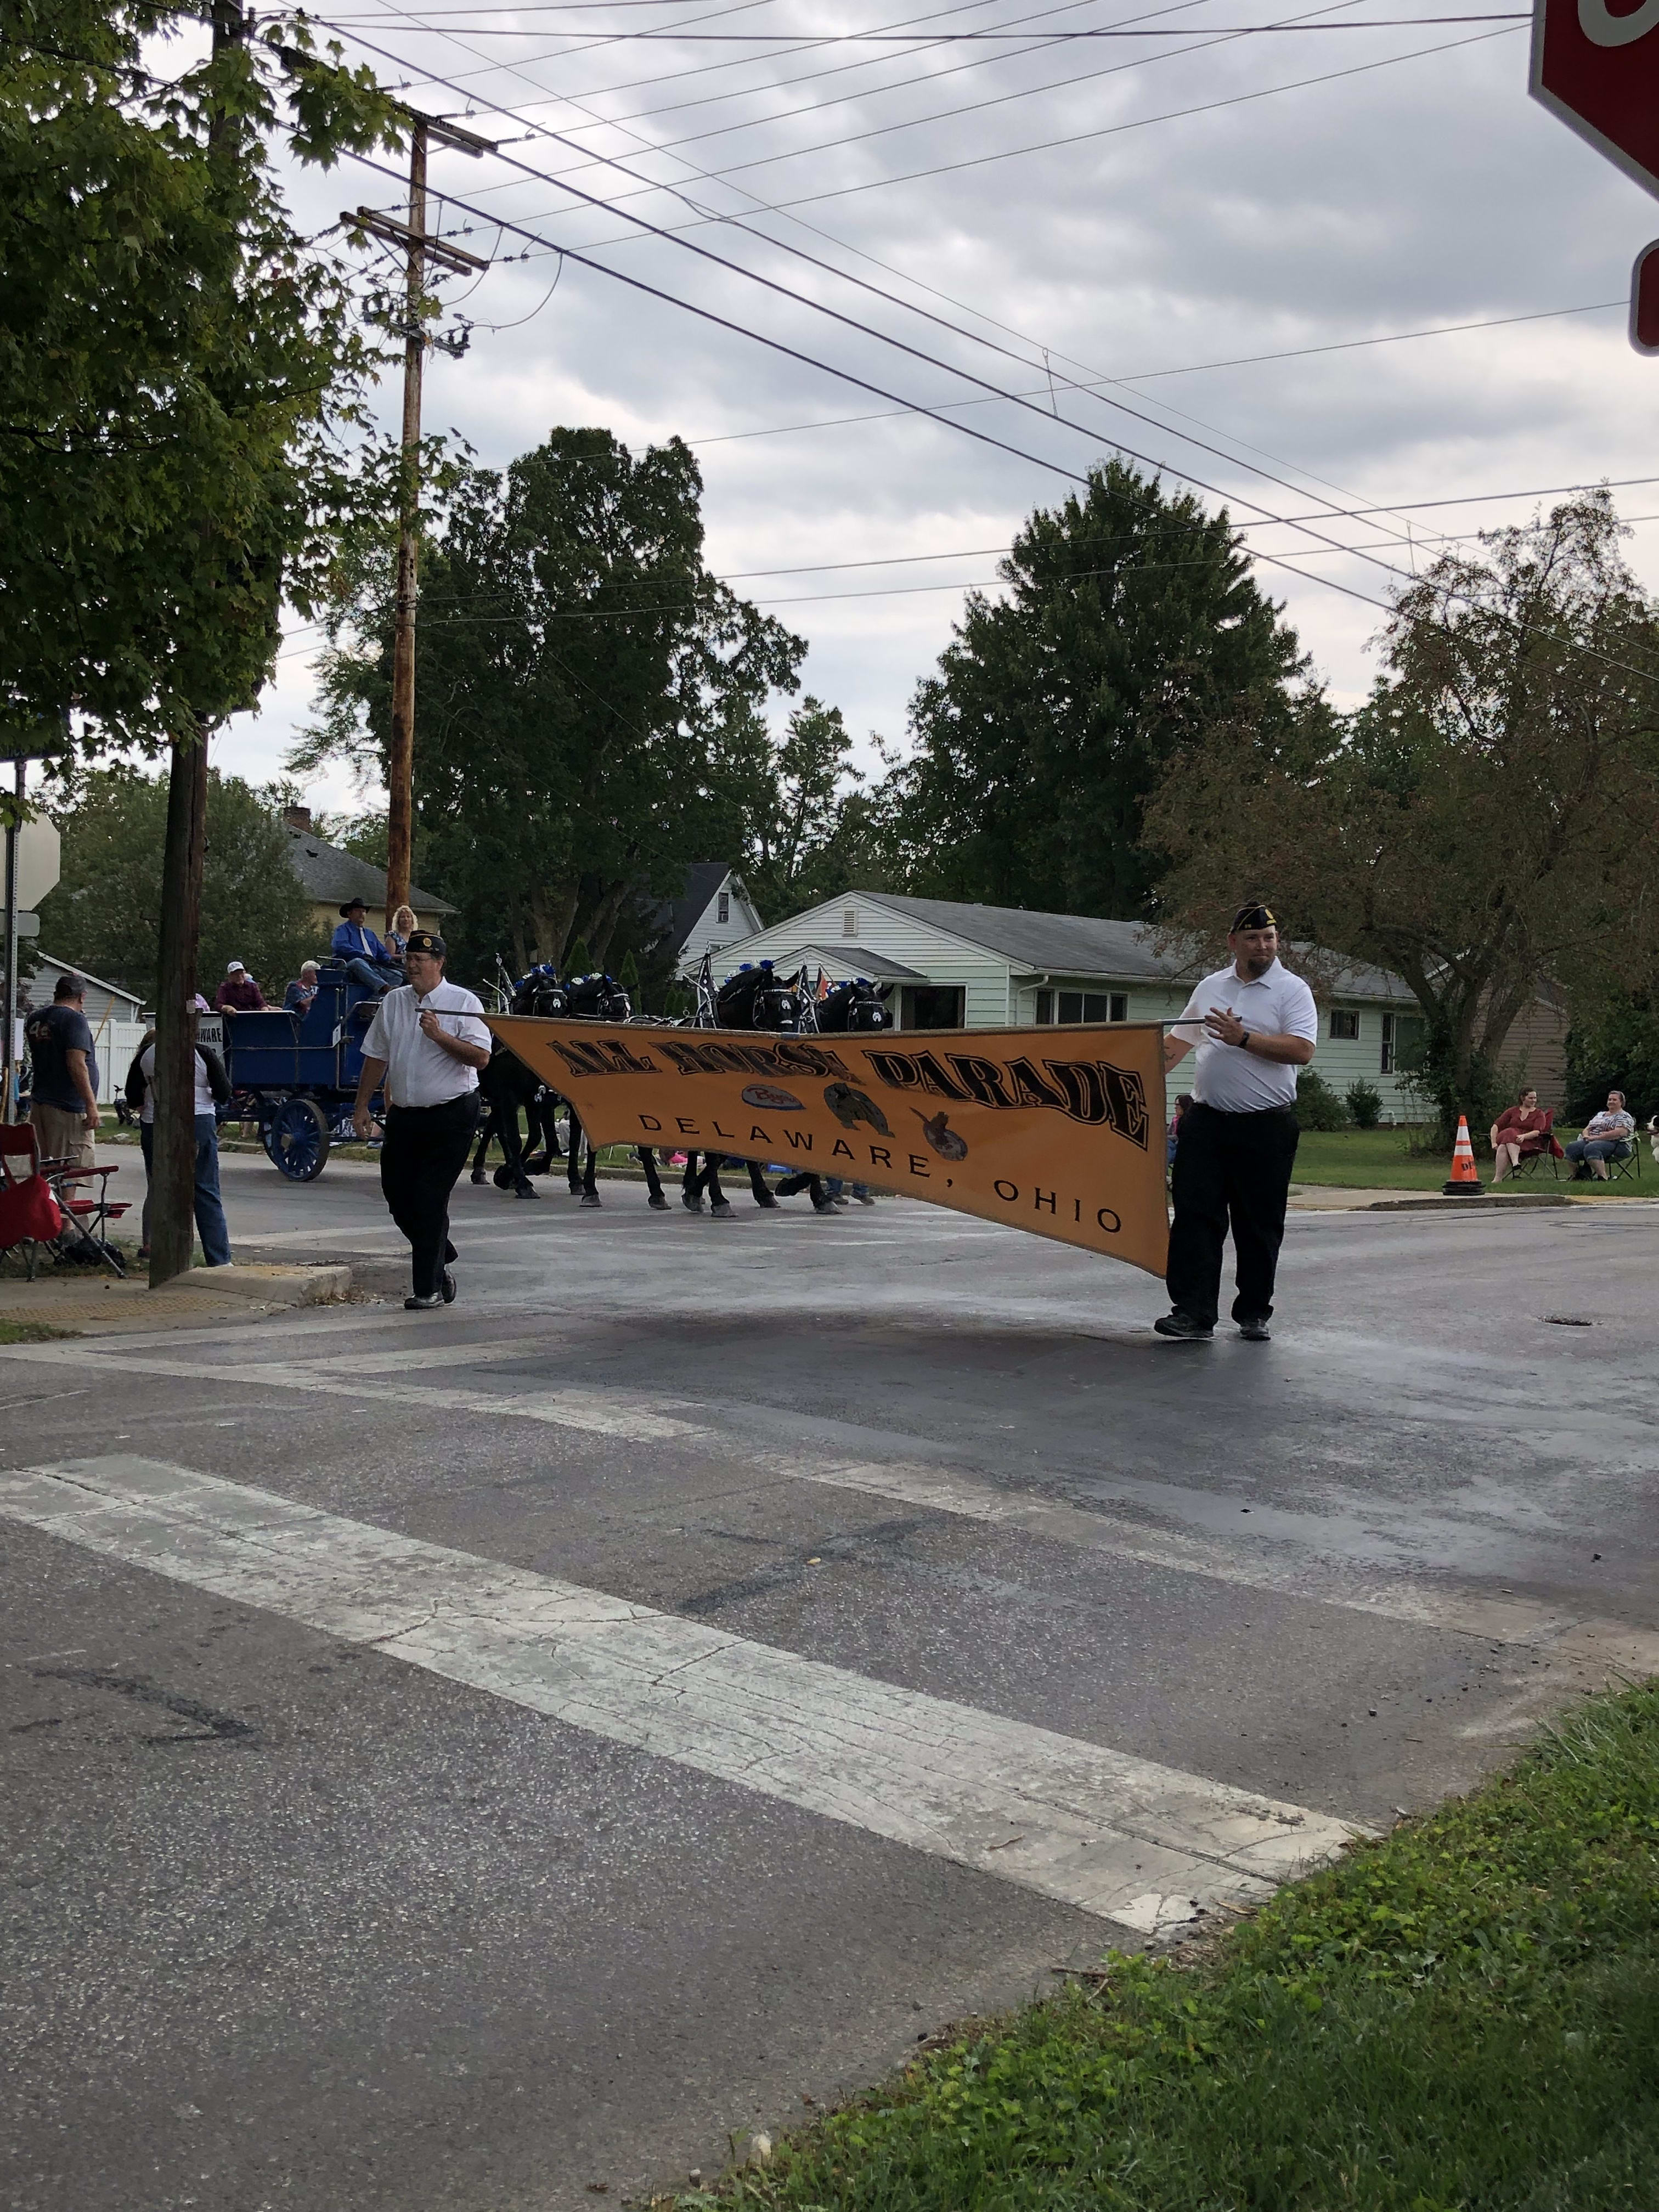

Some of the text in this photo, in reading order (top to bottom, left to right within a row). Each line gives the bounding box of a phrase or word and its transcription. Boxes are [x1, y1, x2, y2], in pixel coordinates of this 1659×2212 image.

[546, 1040, 662, 1077] ALL
[861, 1049, 1149, 1152] PARADE
[637, 1114, 1121, 1233] DELAWARE, OHIO
